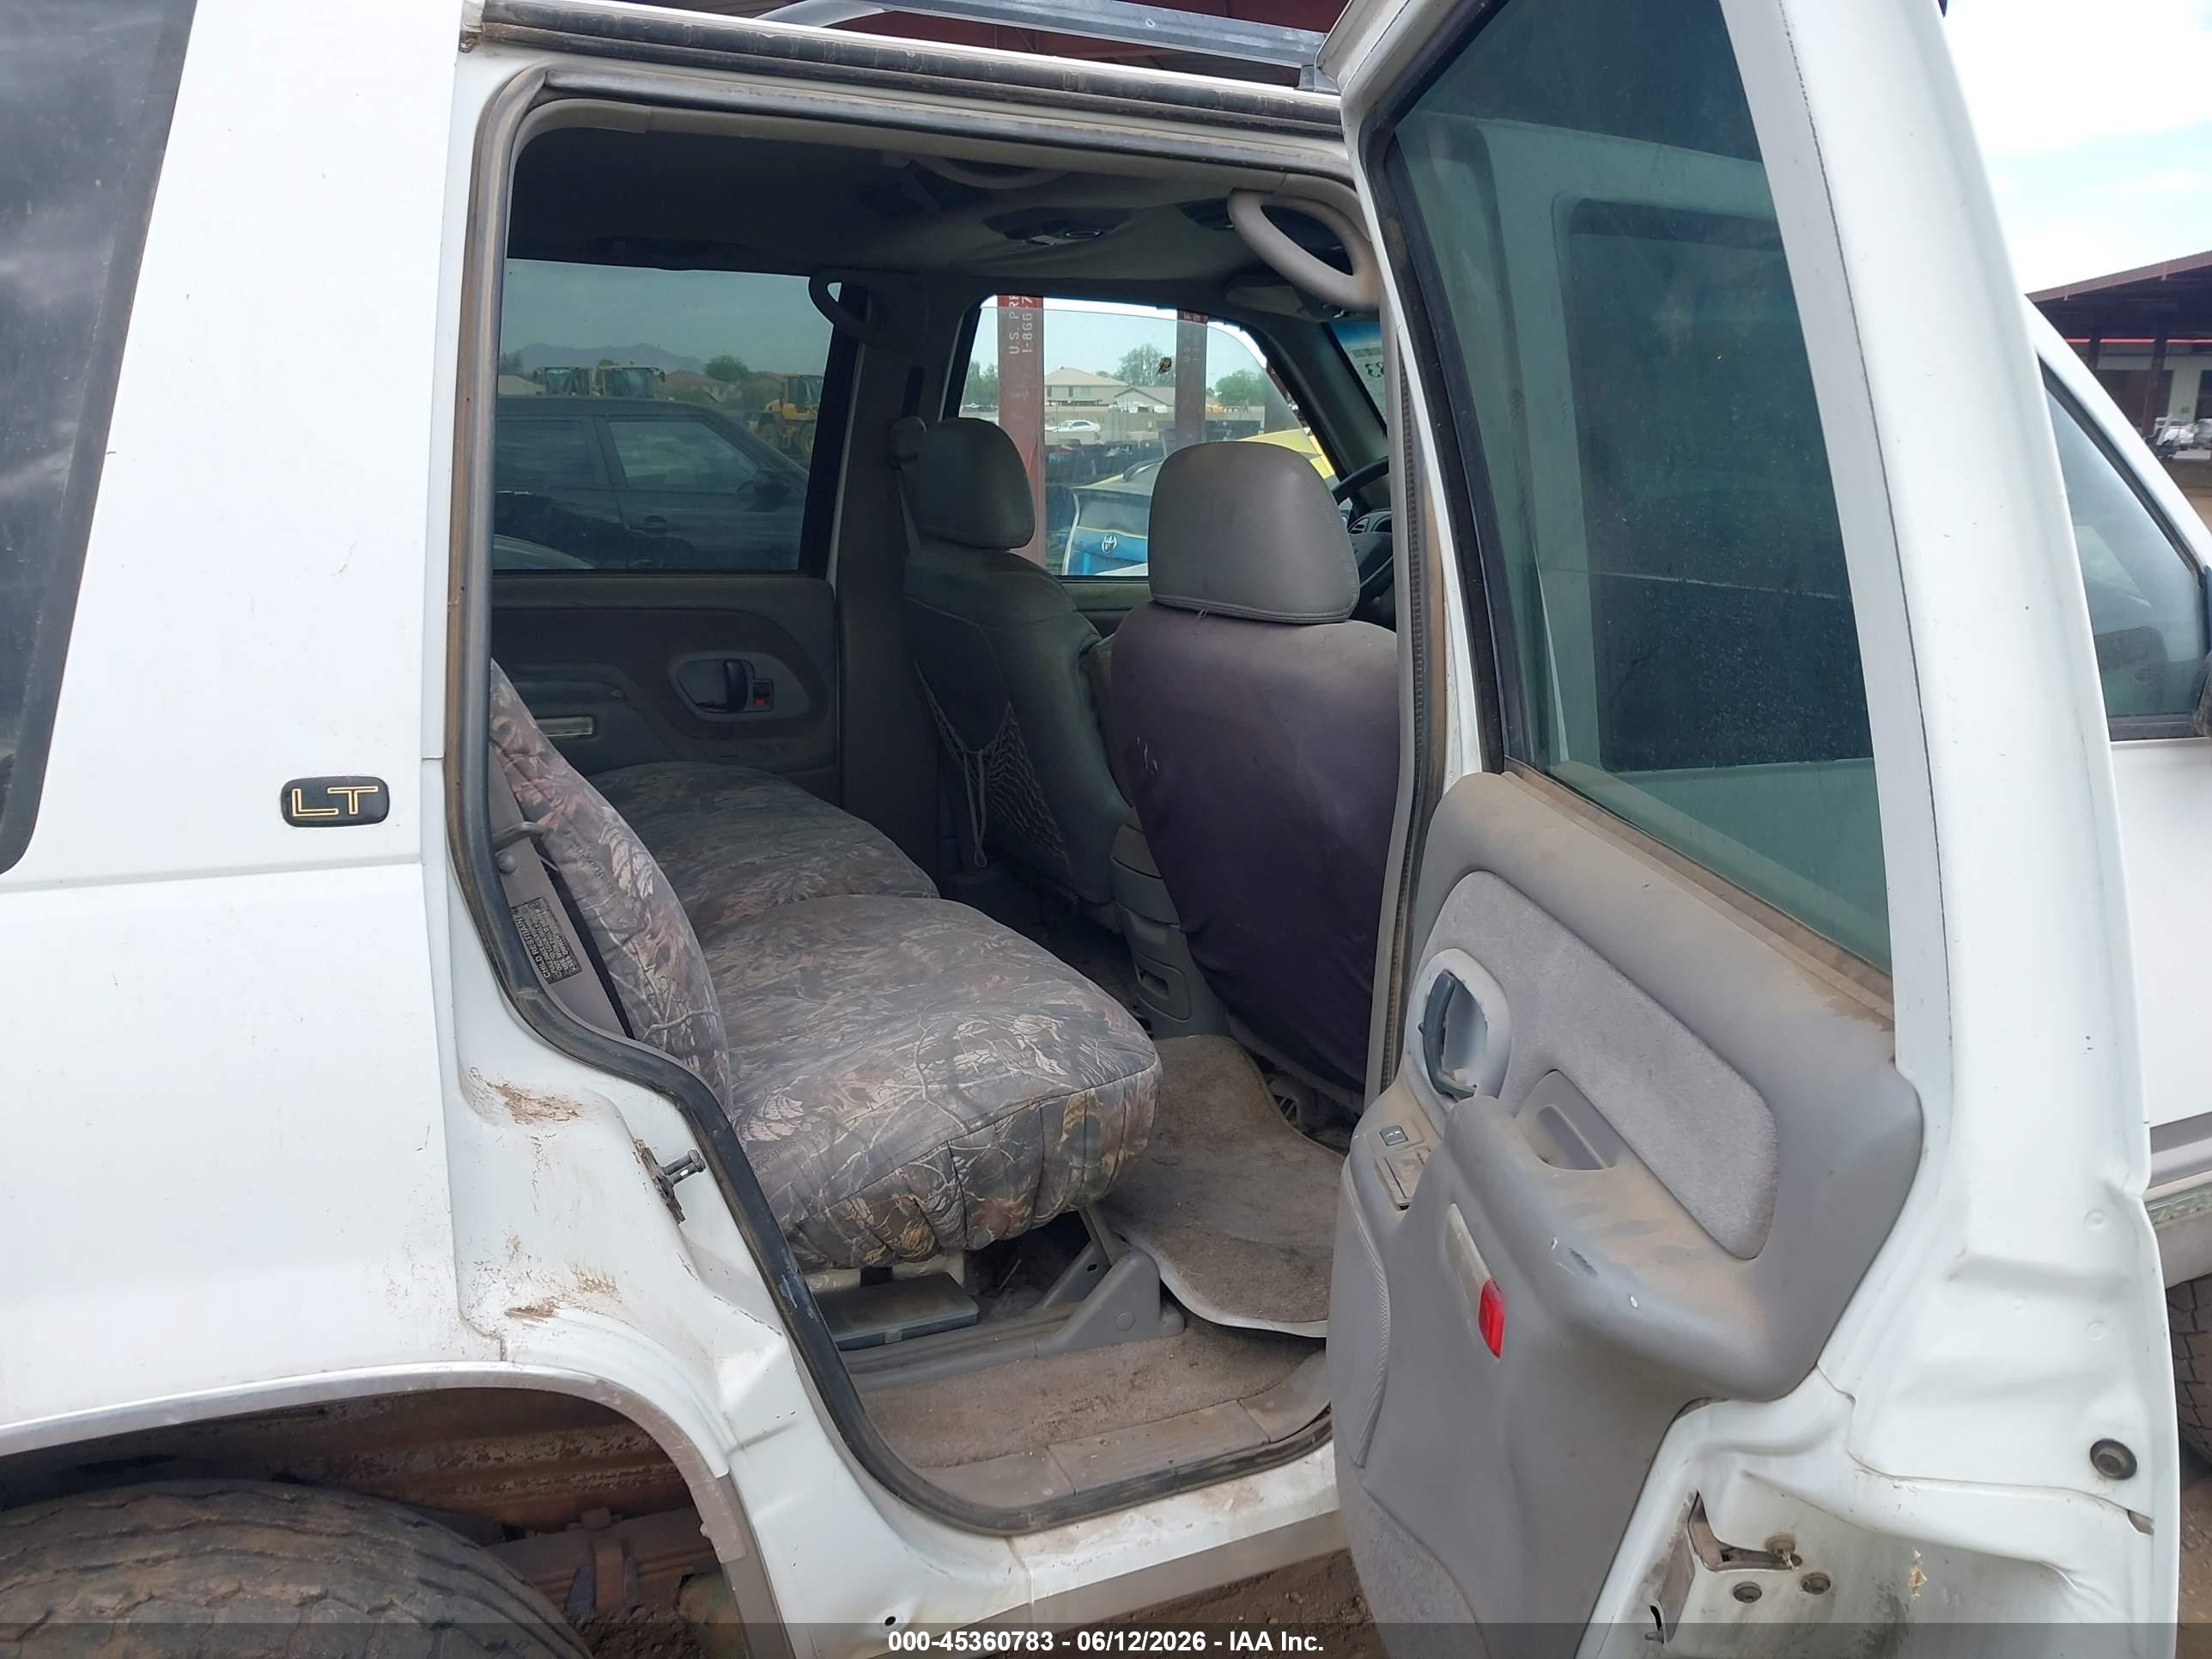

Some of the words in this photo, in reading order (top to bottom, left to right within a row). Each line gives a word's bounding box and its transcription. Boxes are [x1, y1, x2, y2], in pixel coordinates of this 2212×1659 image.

[1009, 327, 1019, 355] U.S.
[292, 786, 378, 817] LT
[534, 955, 550, 978] CHILD
